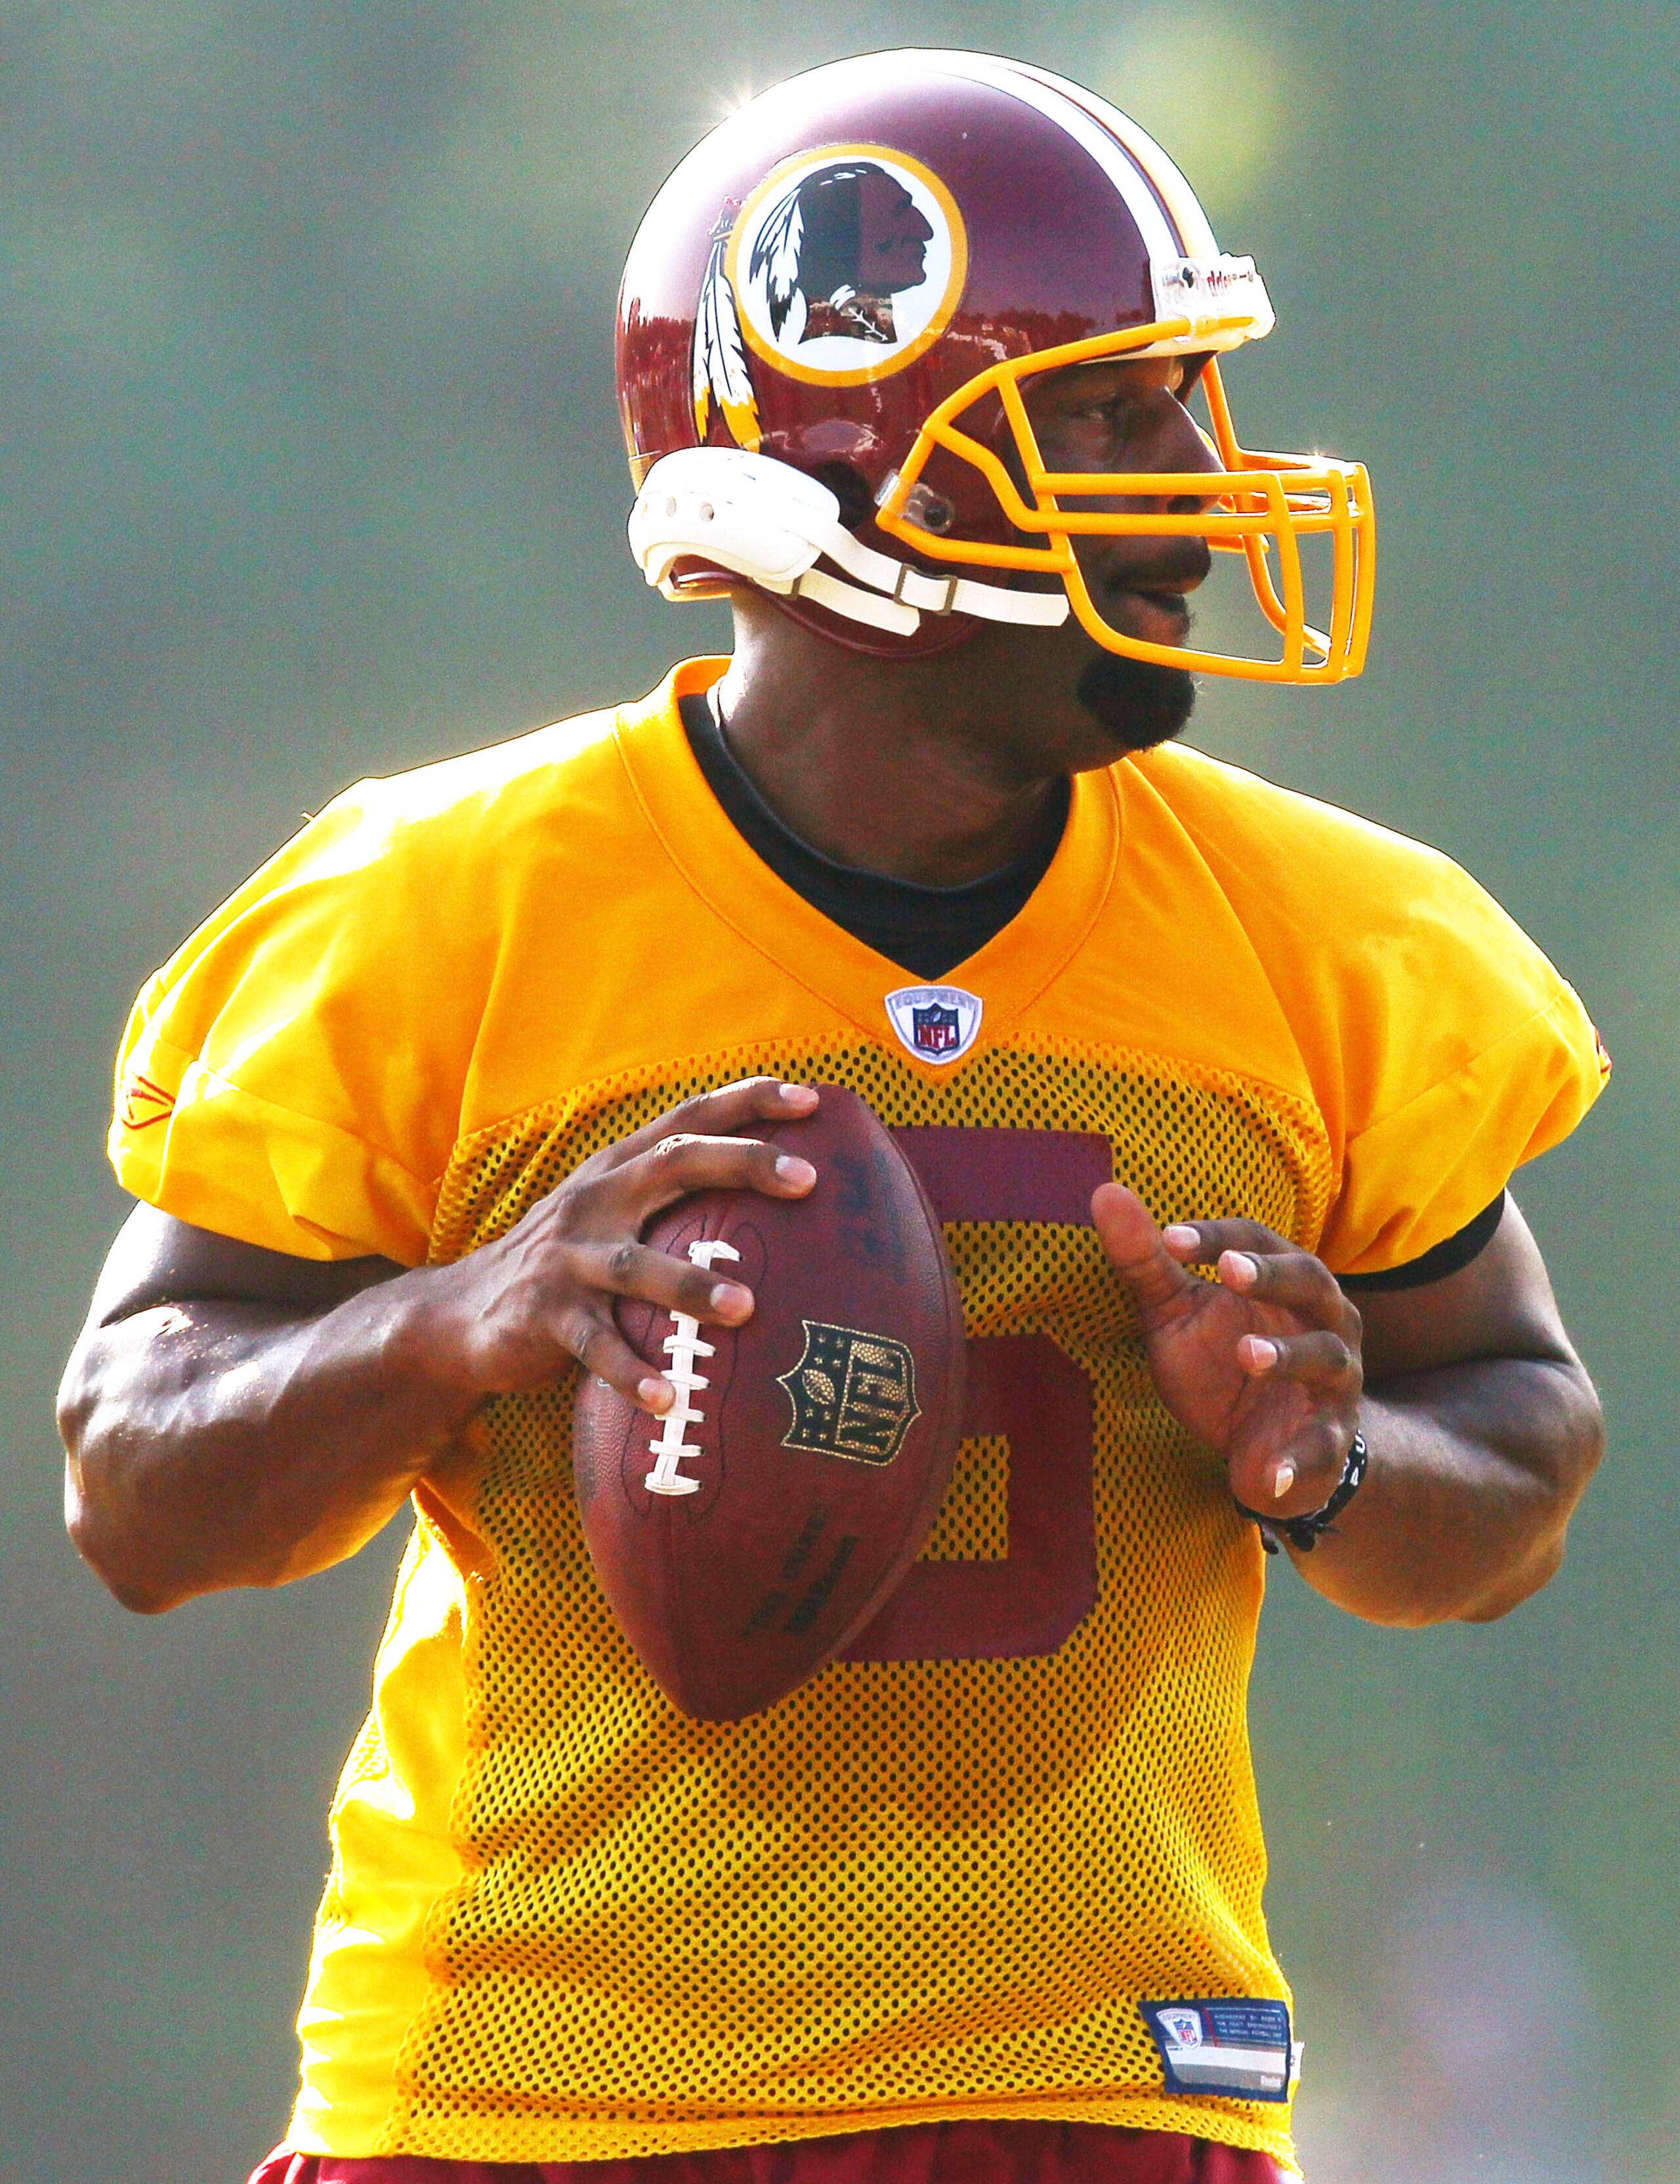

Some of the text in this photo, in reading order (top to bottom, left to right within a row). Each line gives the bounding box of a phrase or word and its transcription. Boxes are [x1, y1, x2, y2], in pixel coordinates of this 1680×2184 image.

[919, 1024, 957, 1049] NFL
[837, 1352, 904, 1449] NFL
[1179, 2028, 1198, 2042] NFL
